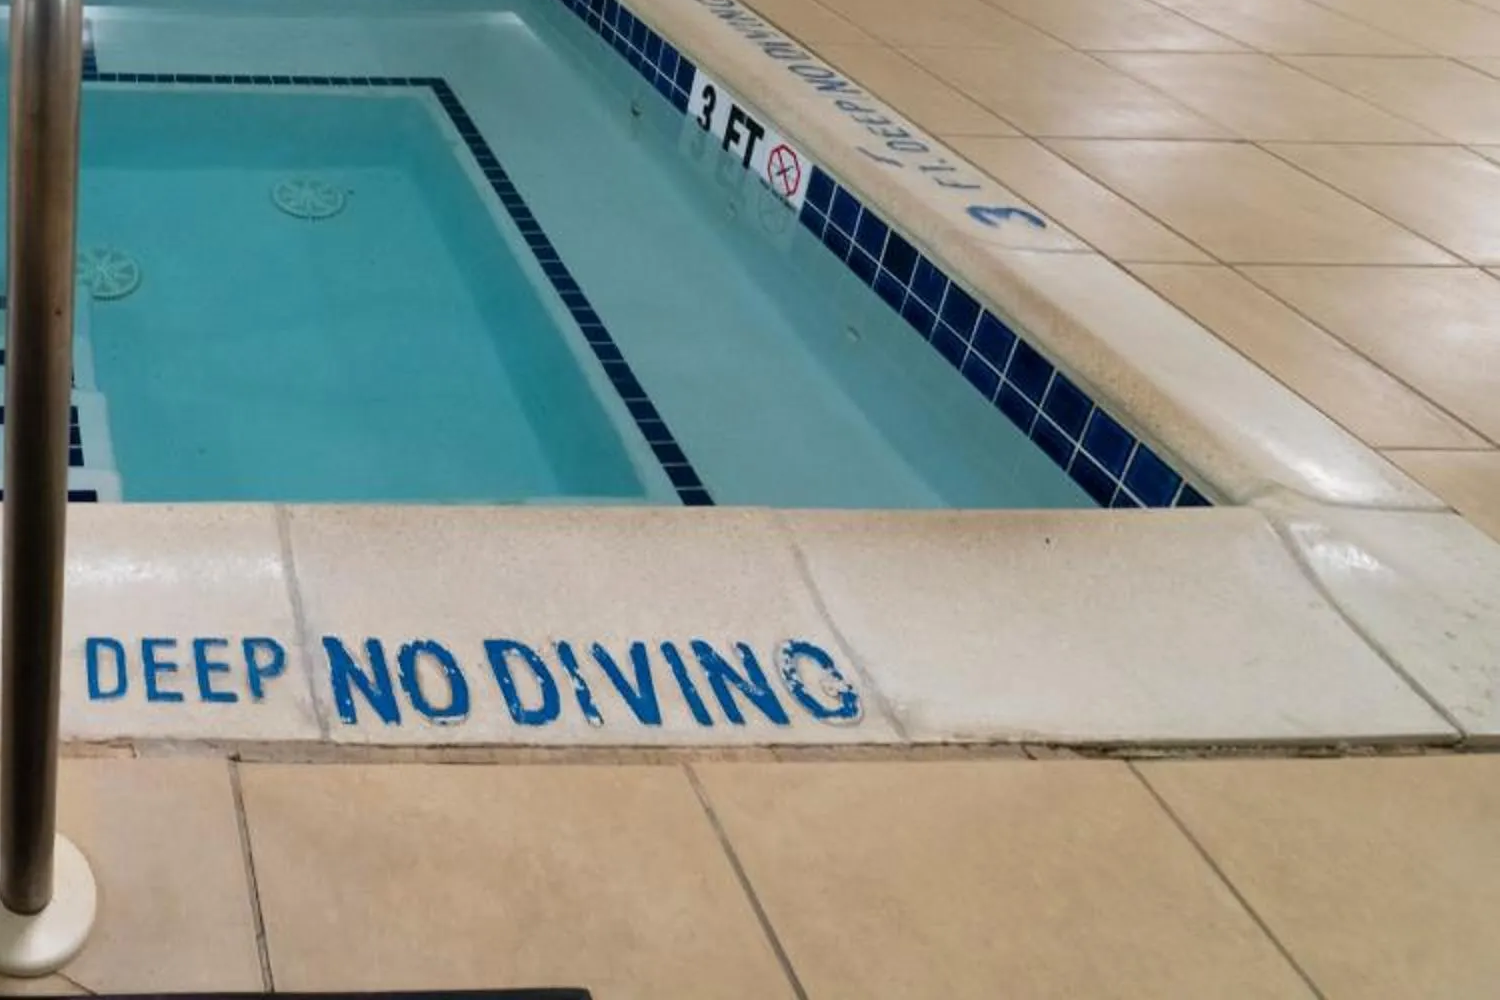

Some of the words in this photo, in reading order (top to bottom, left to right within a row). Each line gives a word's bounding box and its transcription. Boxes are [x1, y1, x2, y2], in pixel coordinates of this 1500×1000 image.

[787, 64, 863, 95] NO
[697, 84, 716, 132] 3
[722, 103, 765, 170] FT
[834, 99, 930, 153] DEEP
[965, 205, 1047, 229] 3
[83, 636, 288, 704] DEEP
[321, 635, 470, 726] NO
[482, 638, 863, 728] DIVING
